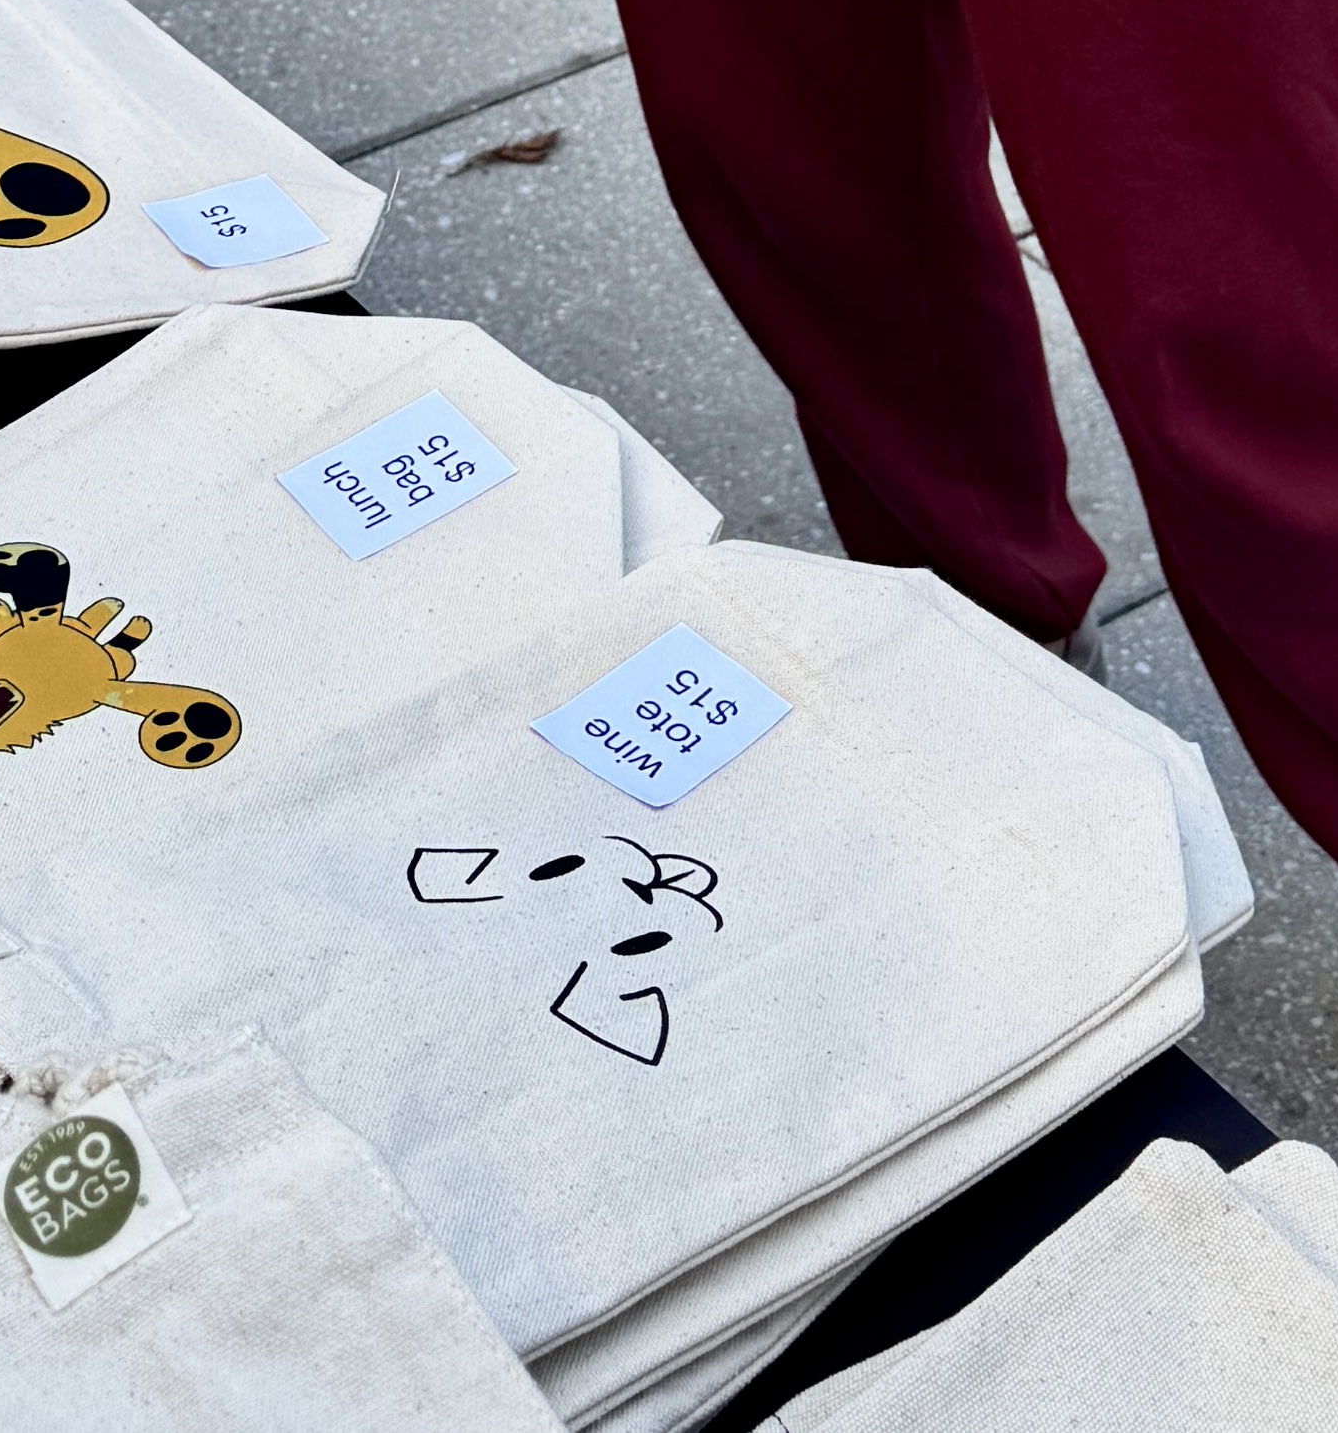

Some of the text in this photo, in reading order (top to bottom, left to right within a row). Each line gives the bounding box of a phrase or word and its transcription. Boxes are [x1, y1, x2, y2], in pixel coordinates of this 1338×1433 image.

[200, 205, 249, 238] $15
[381, 454, 436, 508] bag
[417, 434, 477, 483] $15
[323, 461, 393, 530] lunch
[665, 669, 739, 726] $15
[584, 718, 663, 779] wine
[635, 700, 703, 754] tote
[14, 1131, 112, 1214] ECO
[30, 1158, 131, 1245] BAGS
